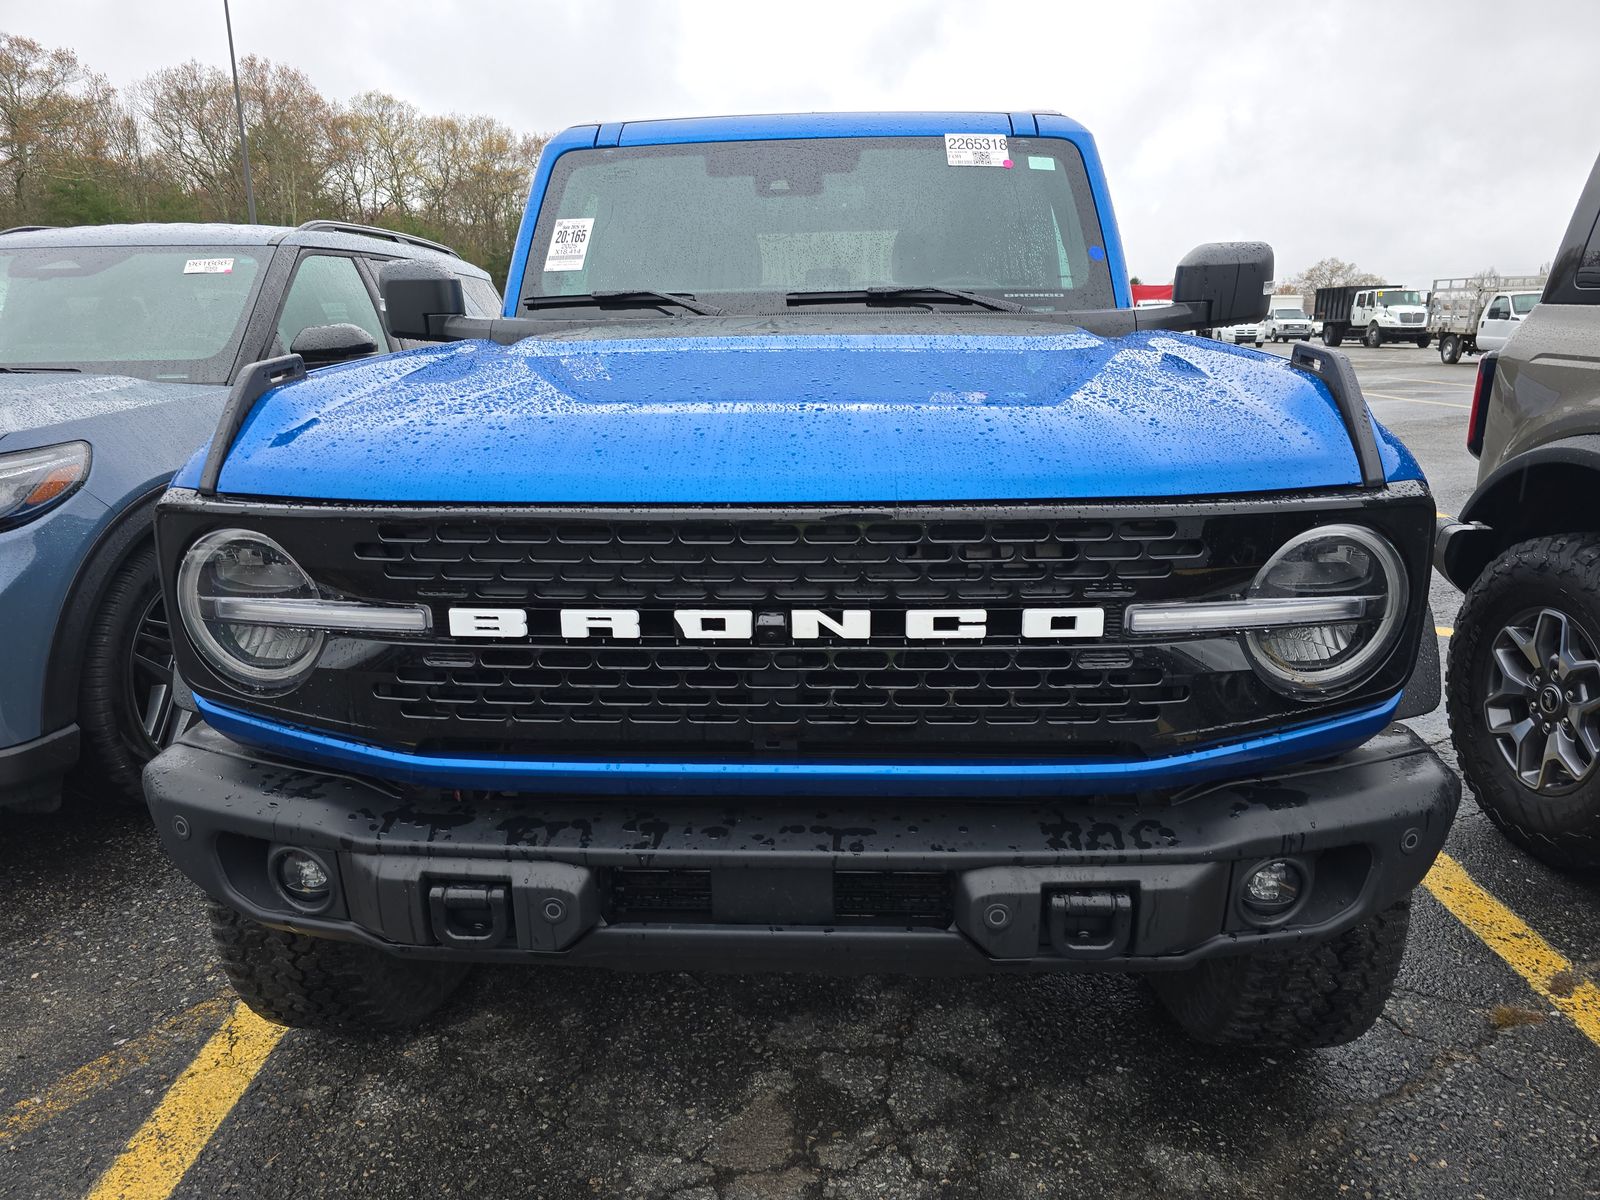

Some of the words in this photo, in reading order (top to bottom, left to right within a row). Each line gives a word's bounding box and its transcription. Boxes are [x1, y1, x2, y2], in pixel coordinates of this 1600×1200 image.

[948, 137, 1008, 150] 2265318
[555, 230, 587, 243] 20:165
[448, 607, 1105, 640] BRONCO
